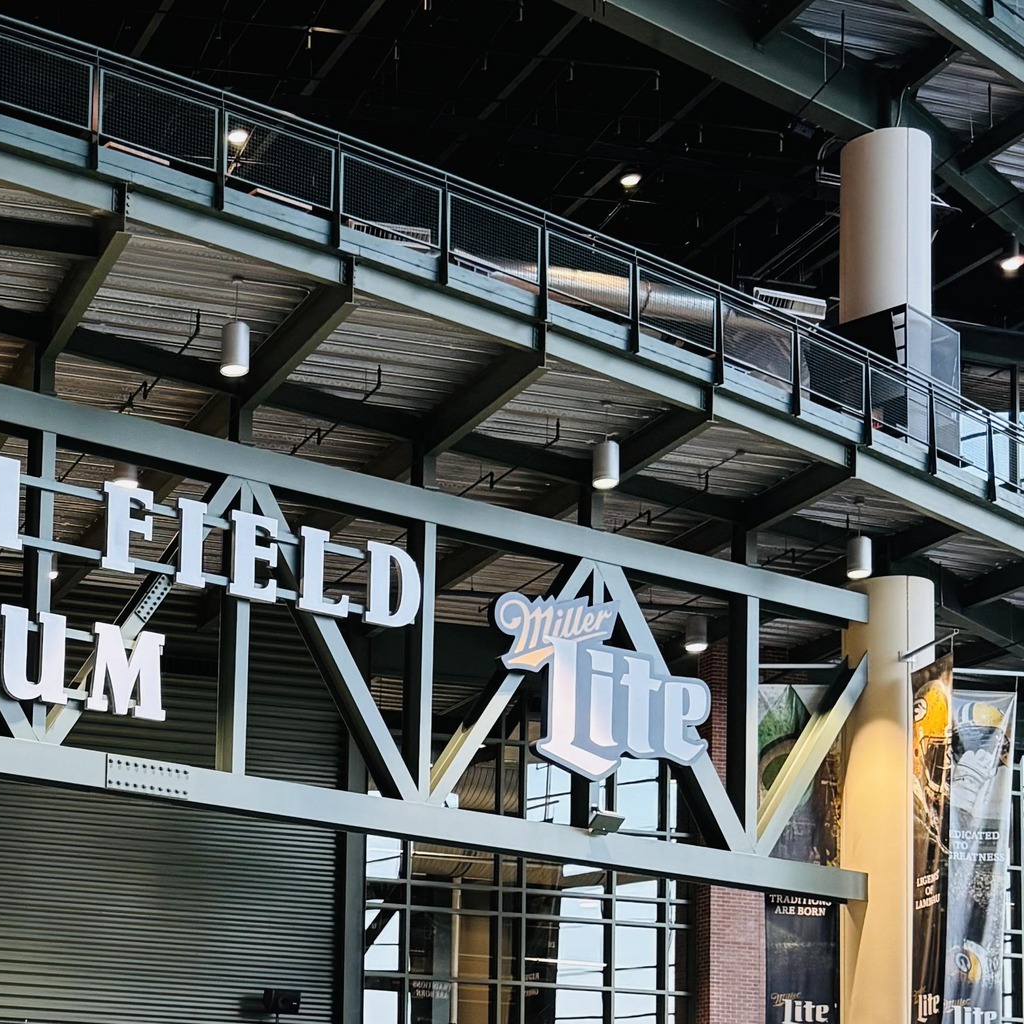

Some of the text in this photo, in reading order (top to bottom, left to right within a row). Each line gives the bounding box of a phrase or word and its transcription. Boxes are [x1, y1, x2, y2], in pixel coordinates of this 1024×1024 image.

[101, 481, 421, 628] FIELD
[500, 599, 612, 660] Miller
[539, 635, 708, 776] Lite
[949, 830, 1000, 841] EDICATED
[954, 841, 969, 850] TO
[774, 905, 826, 917] ARE BORN
[917, 992, 941, 1024] Lite
